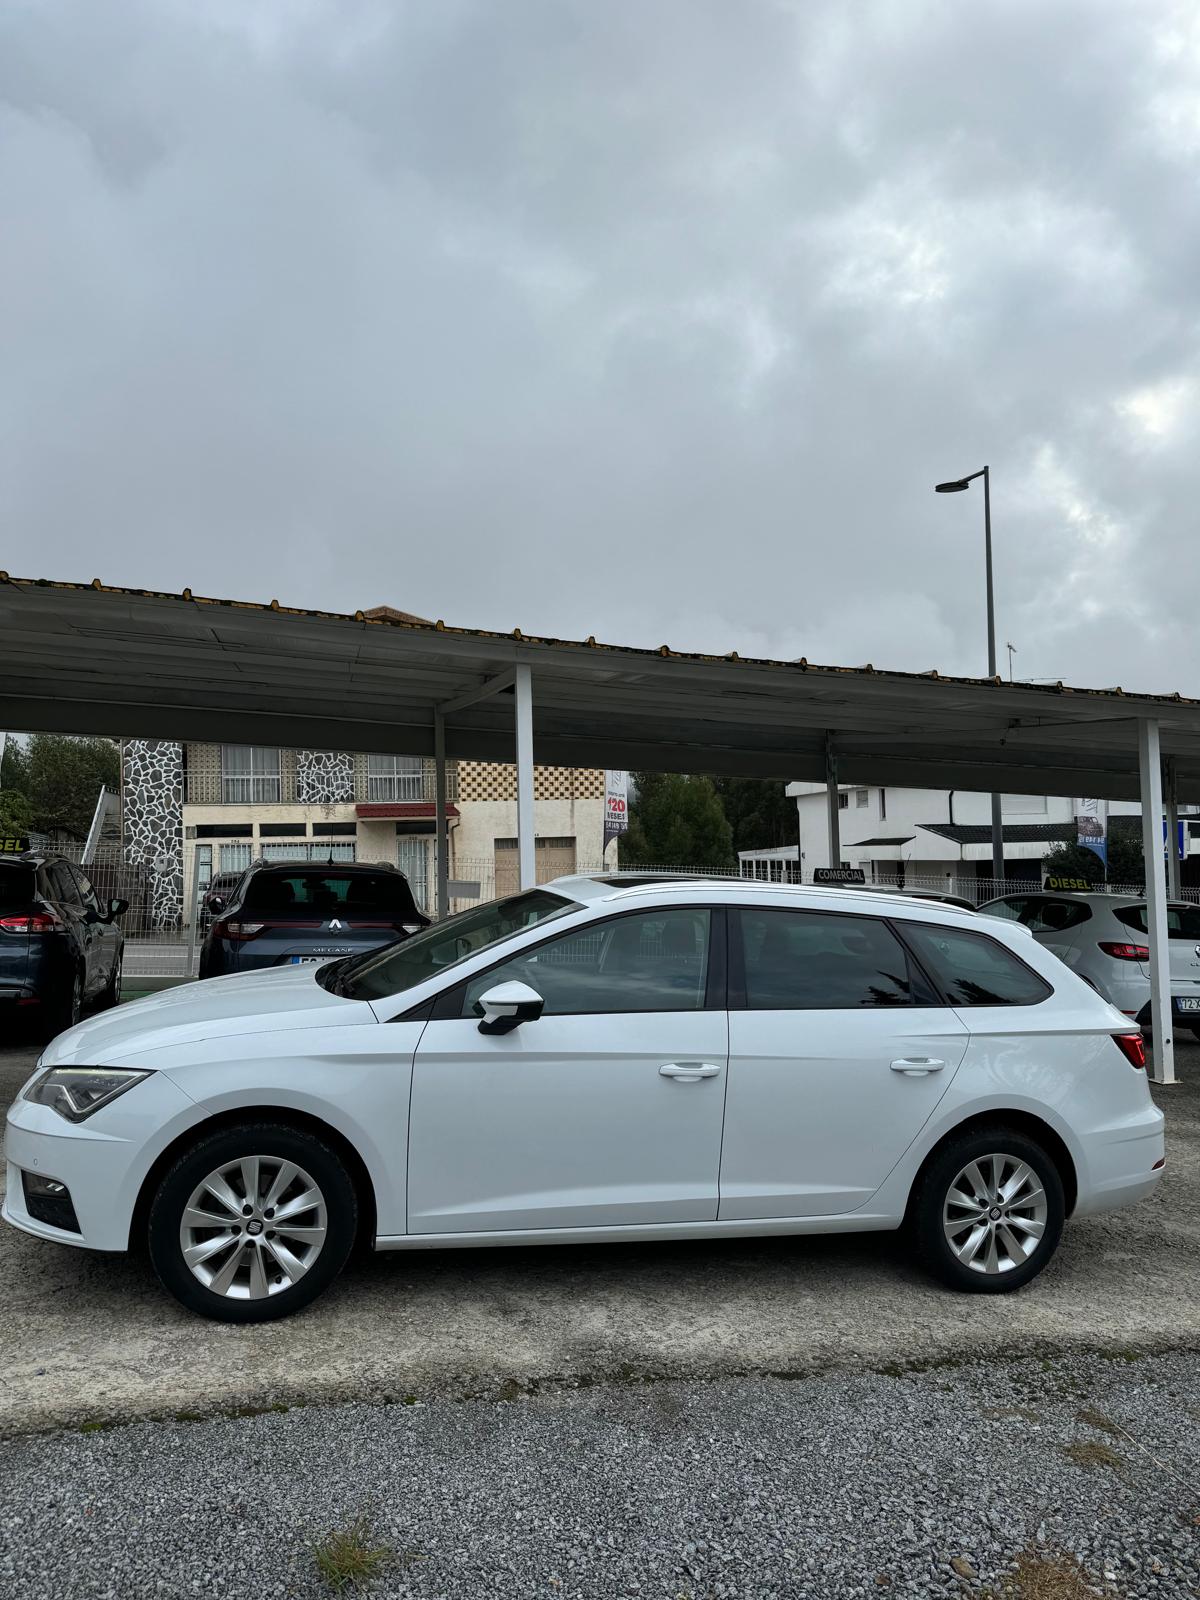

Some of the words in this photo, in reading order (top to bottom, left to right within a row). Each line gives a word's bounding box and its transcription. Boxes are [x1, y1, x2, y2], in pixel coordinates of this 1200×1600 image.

[608, 797, 625, 812] 120
[818, 870, 864, 880] COMERCIAL
[1049, 877, 1091, 889] DIESEL
